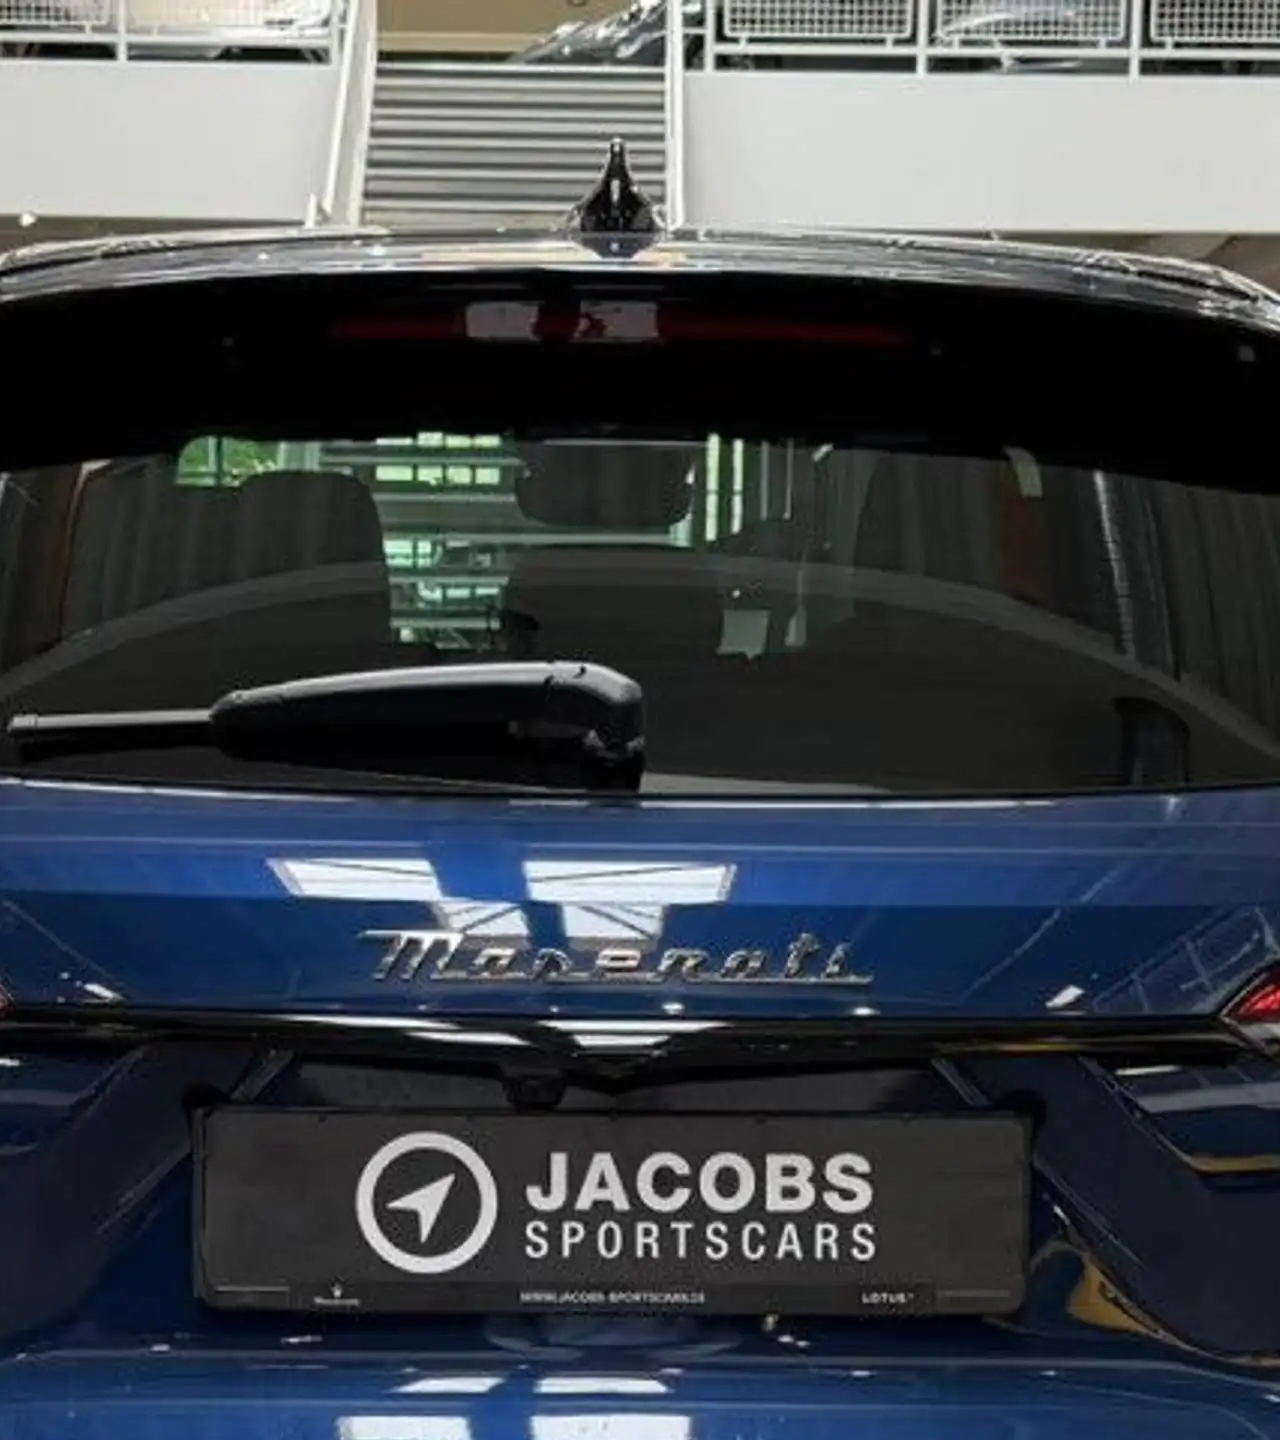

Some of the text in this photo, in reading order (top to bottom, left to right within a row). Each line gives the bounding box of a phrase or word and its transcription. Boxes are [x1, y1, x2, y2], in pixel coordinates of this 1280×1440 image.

[357, 928, 874, 984] Maserati
[525, 1151, 873, 1213] JACOBS
[525, 1219, 876, 1260] SPORTSCARS
